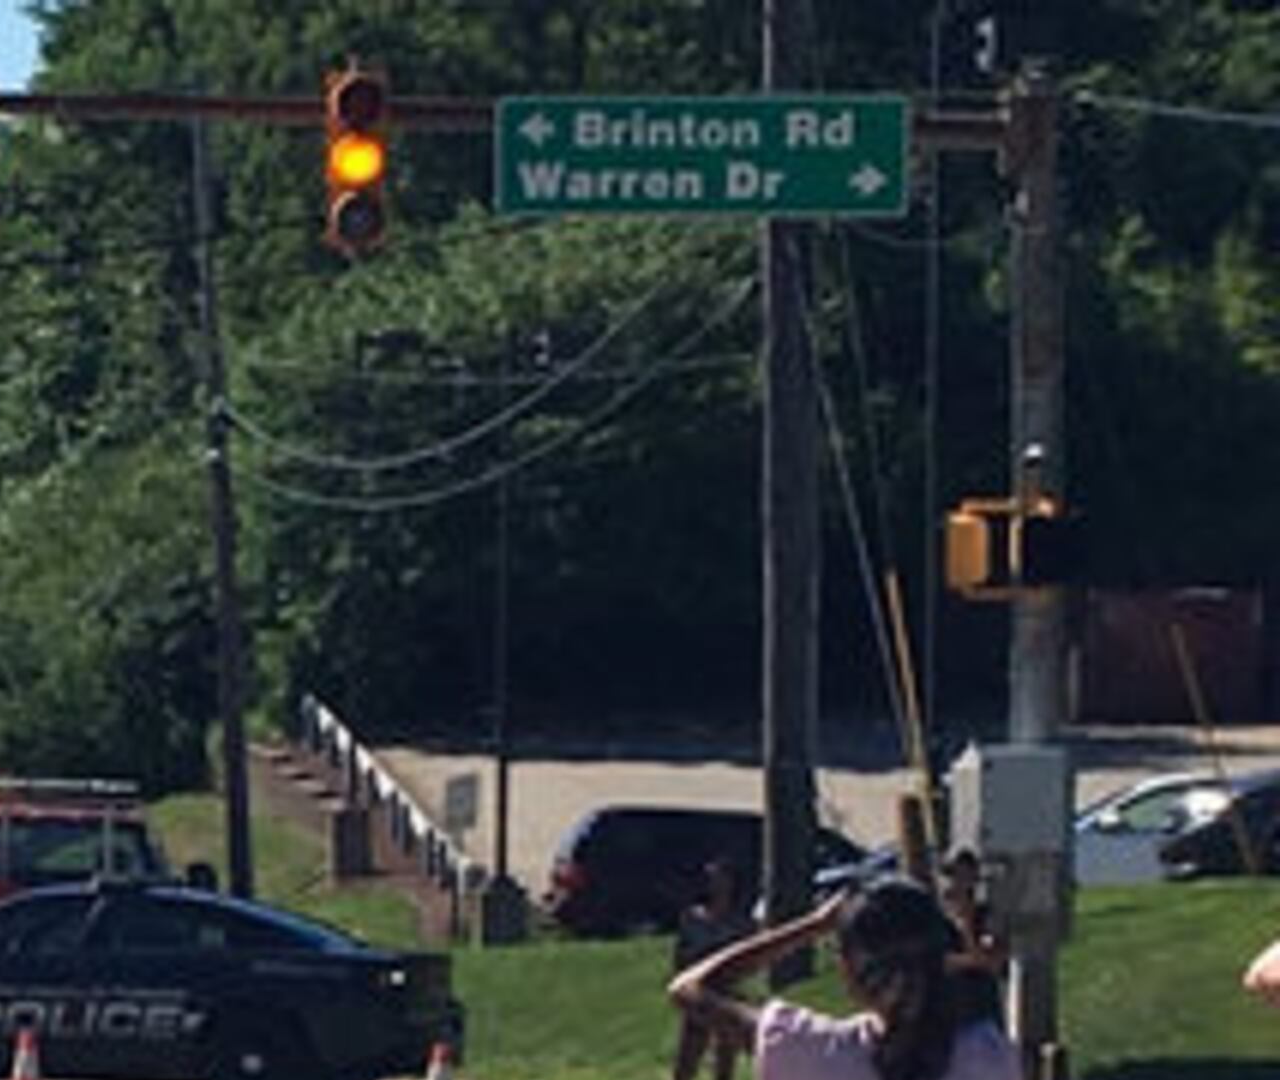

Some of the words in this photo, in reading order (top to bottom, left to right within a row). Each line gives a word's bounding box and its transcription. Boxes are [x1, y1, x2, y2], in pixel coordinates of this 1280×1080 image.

[574, 110, 760, 147] Brinton
[787, 110, 854, 147] Rd
[518, 162, 703, 198] Warren
[726, 162, 784, 198] Dr
